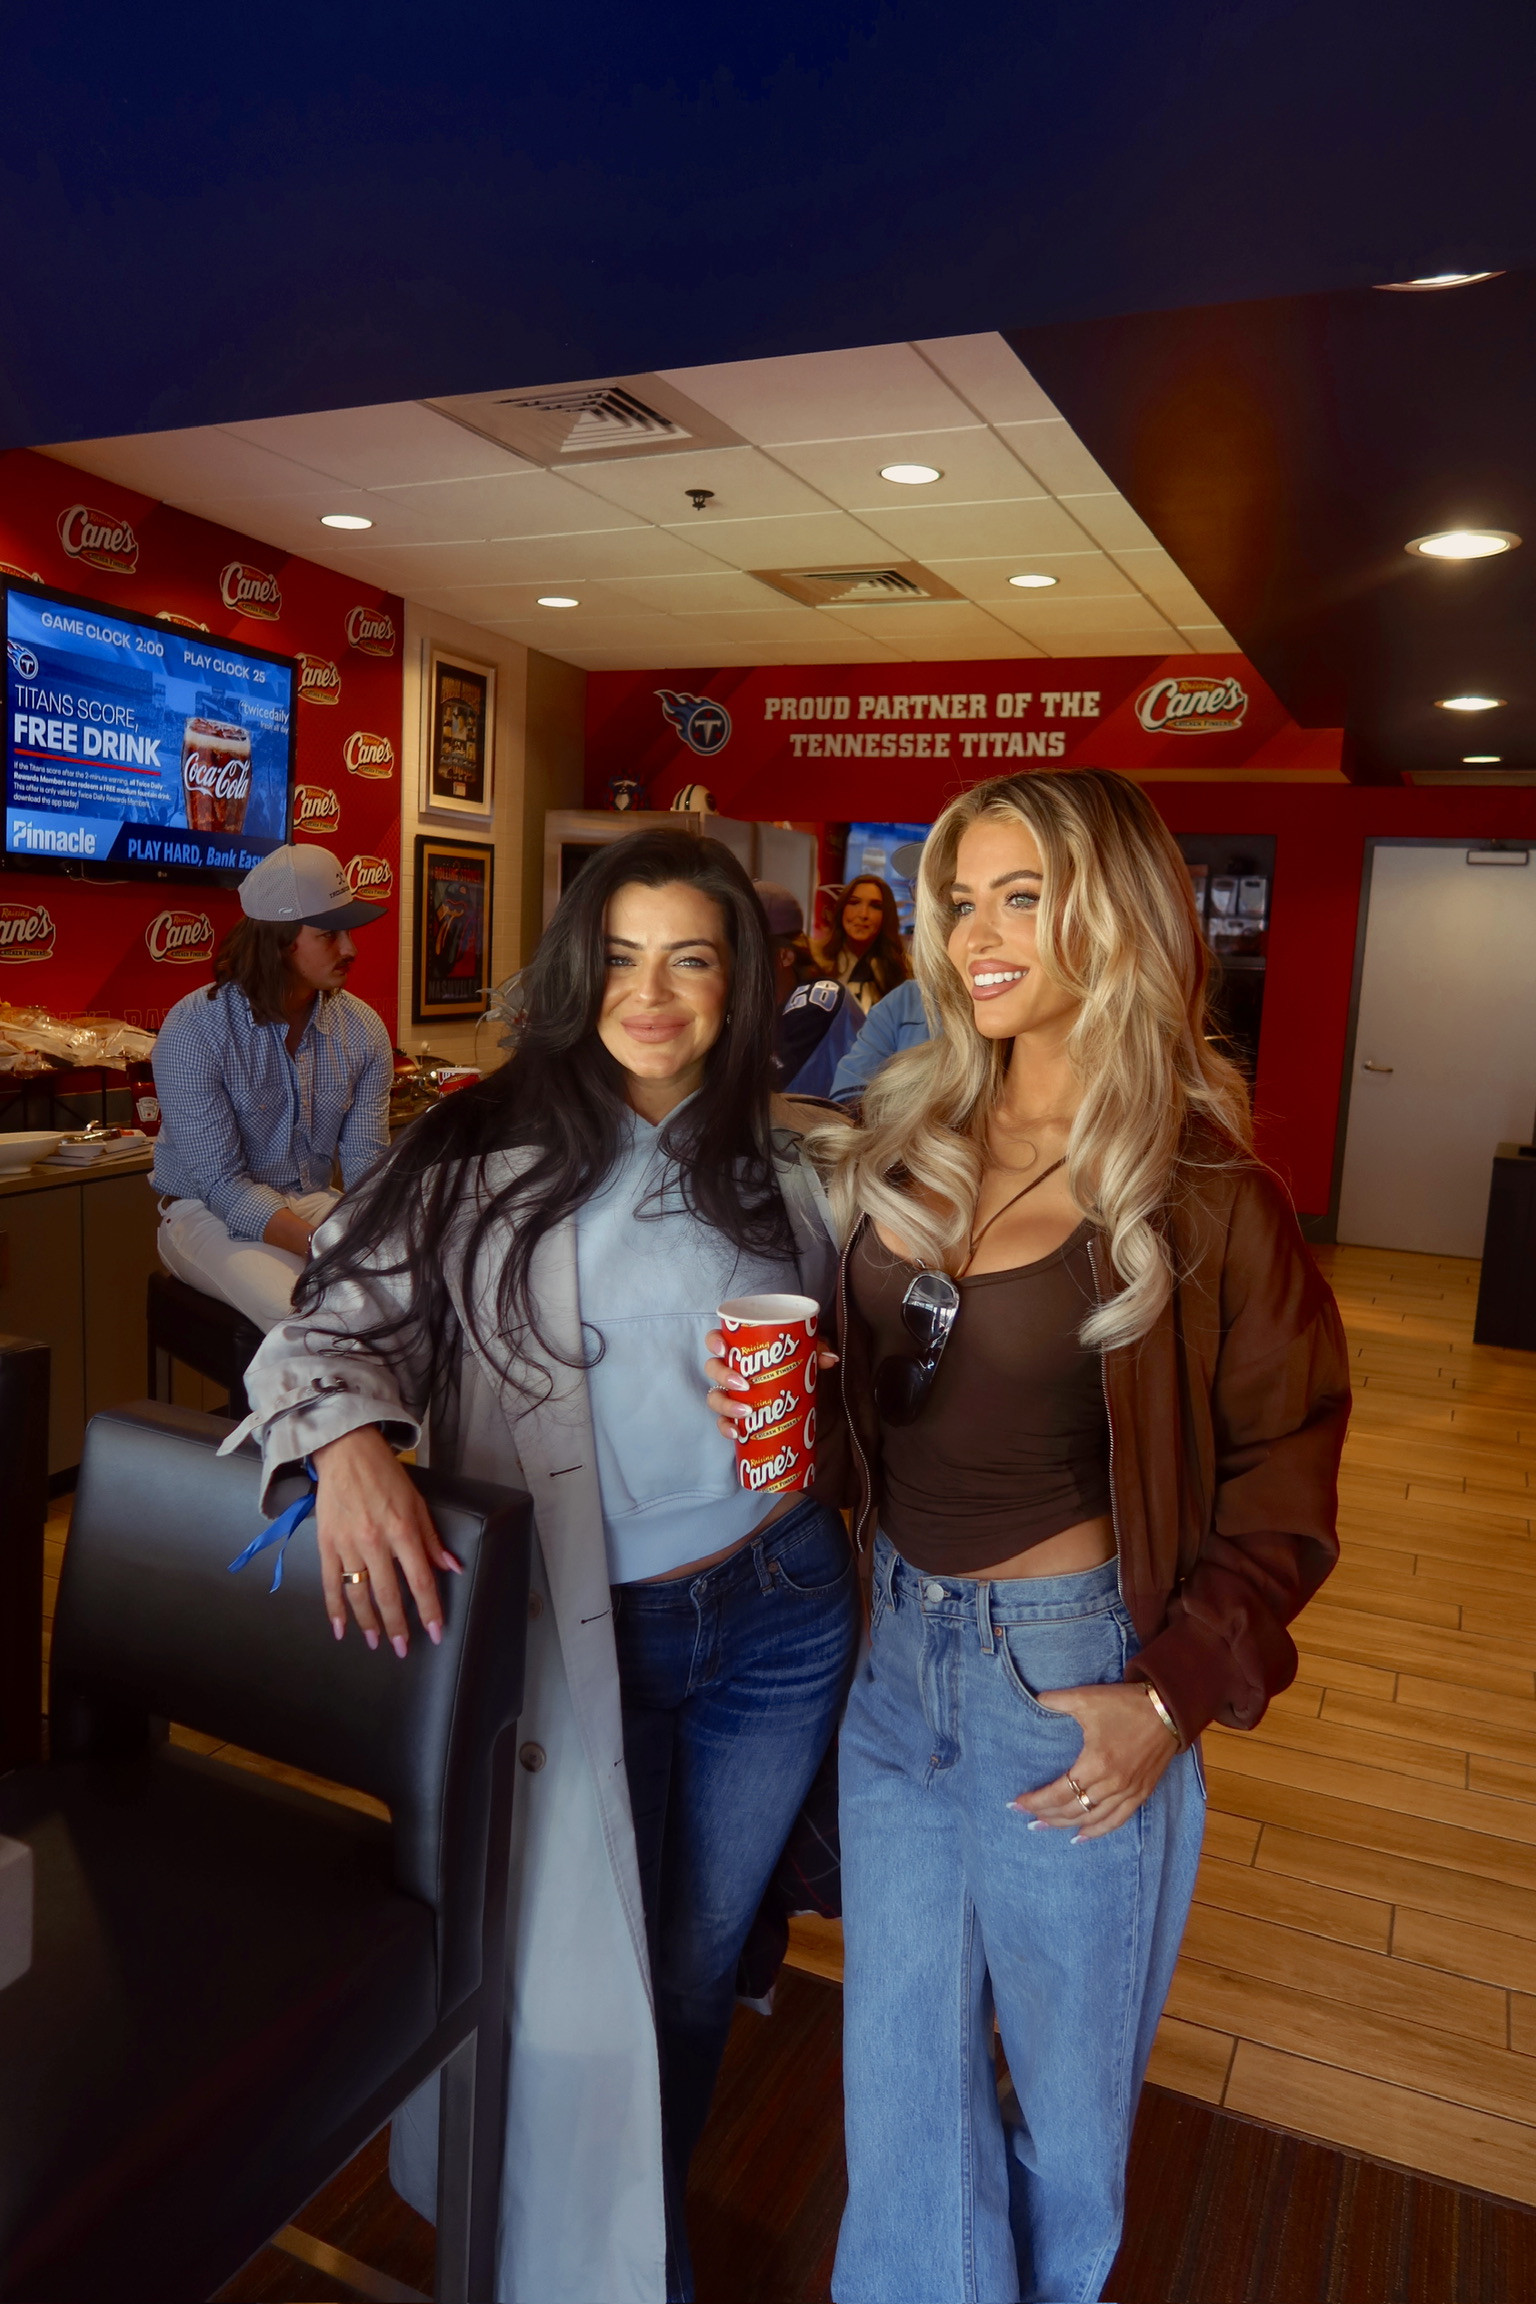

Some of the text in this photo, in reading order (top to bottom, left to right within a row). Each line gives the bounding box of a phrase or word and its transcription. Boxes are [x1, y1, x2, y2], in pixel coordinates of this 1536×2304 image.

[62, 504, 137, 554] Cane's
[222, 562, 280, 605] Cane's
[41, 612, 164, 657] GAME CLOCK 2:00
[347, 606, 394, 643] Cane's
[183, 651, 266, 683] PLAY CLOCK 25
[1141, 677, 1244, 729] Cane's
[1179, 681, 1215, 691] Raising
[15, 684, 139, 733] TITANS SCORE,
[764, 691, 1101, 720] PROUD PARTNER OF THE
[14, 713, 161, 767] FREE DRINK
[347, 732, 394, 771] Cane's
[789, 731, 1066, 758] TENNESSEE TITANS
[19, 762, 29, 770] the
[184, 752, 250, 799] Coca-Cola
[103, 784, 116, 792] FREE
[13, 819, 96, 855] Pinnacle
[128, 838, 162, 861] PLAY
[164, 841, 203, 867] HARD,
[206, 846, 238, 868] Bank
[347, 855, 392, 894] Cane's
[1, 907, 30, 919] Raising
[150, 910, 213, 958] Cane's
[728, 1333, 800, 1378] Cane's
[741, 1341, 770, 1355] Raising
[776, 1361, 800, 1376] FINGERS
[755, 1418, 799, 1439] CHICKEN FINGERS
[740, 1445, 799, 1491] Cane's
[750, 1454, 775, 1467] Raising
[779, 1473, 799, 1488] FINGERS
